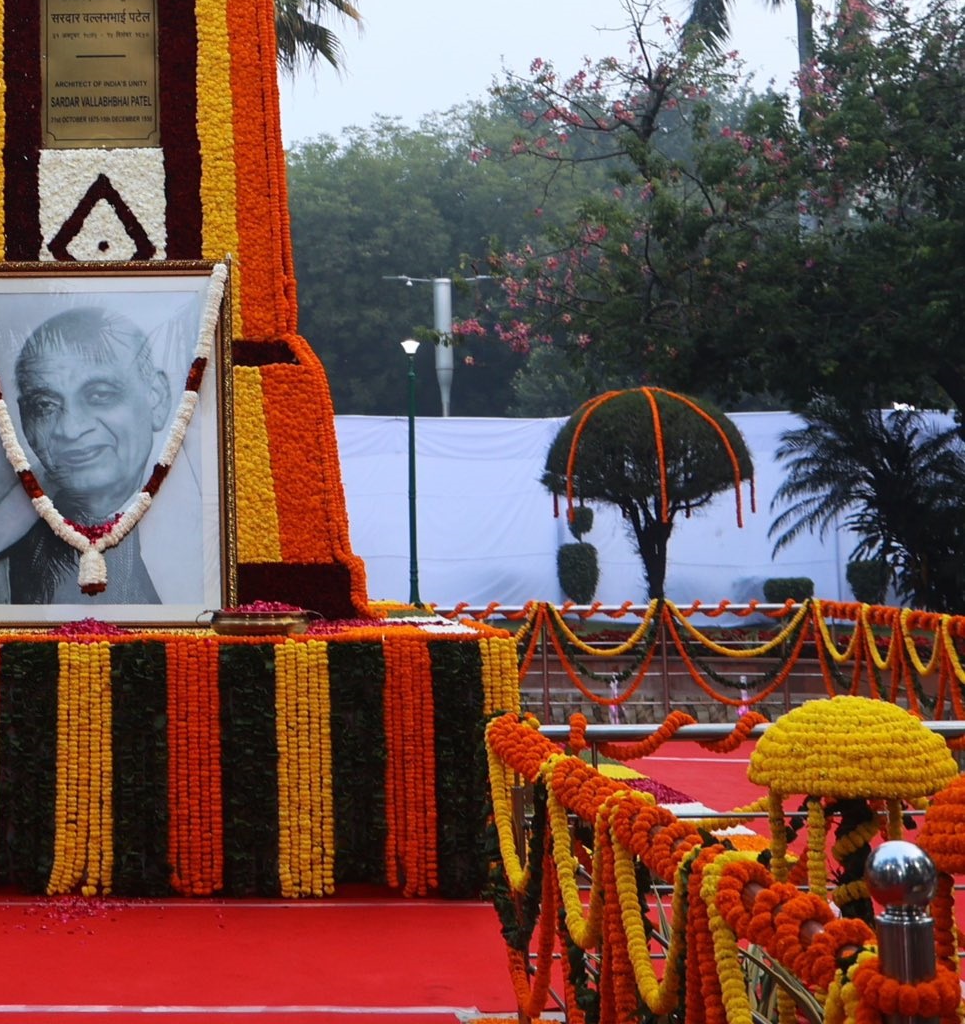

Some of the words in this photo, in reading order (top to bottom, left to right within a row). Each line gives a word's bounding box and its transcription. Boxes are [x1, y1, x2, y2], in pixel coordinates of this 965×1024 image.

[51, 13, 80, 24] सरदार
[82, 8, 126, 24] वल्लभभाई
[129, 9, 151, 23] पटेल
[55, 80, 91, 88] ARCHITECT
[93, 80, 102, 88] OF
[51, 96, 80, 108] SARDAR
[81, 95, 130, 108] VALLABHBHAI
[131, 95, 152, 107] PATEL
